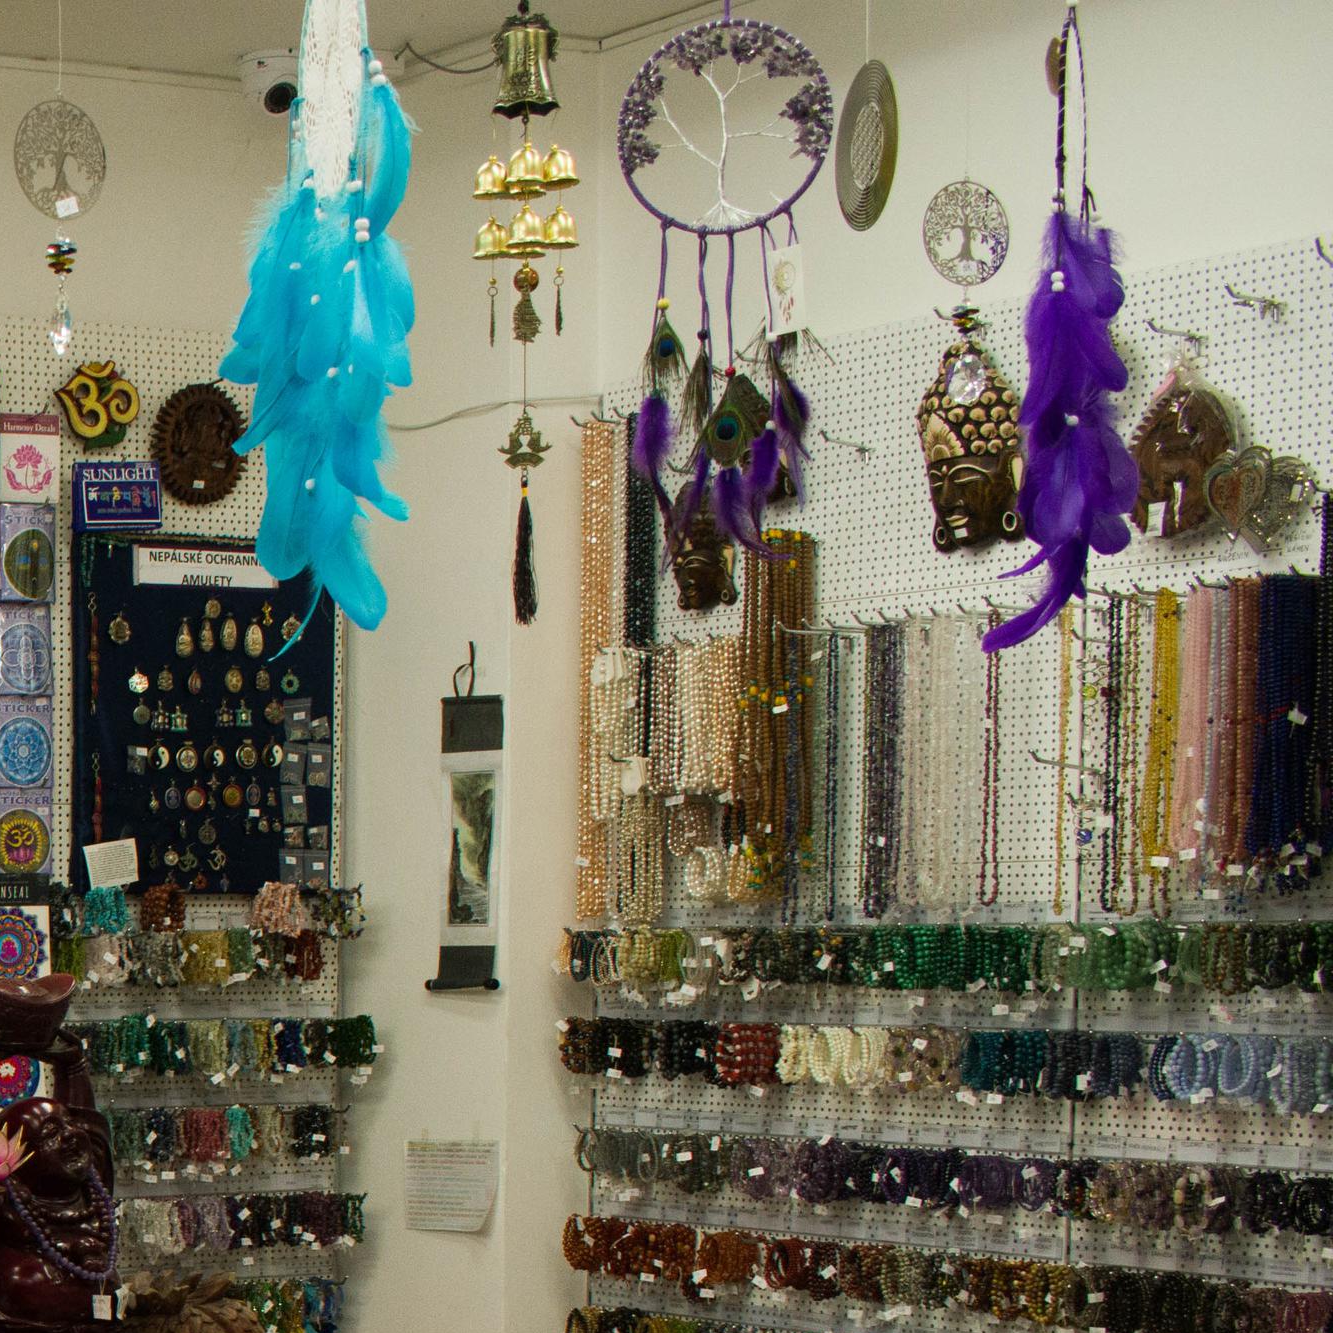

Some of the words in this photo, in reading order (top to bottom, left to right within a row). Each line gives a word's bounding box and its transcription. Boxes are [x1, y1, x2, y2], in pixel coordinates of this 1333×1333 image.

[83, 467, 156, 481] SUNLIGHT
[149, 550, 202, 564] NEPÁLSKÉ
[182, 574, 232, 587] AMULETY
